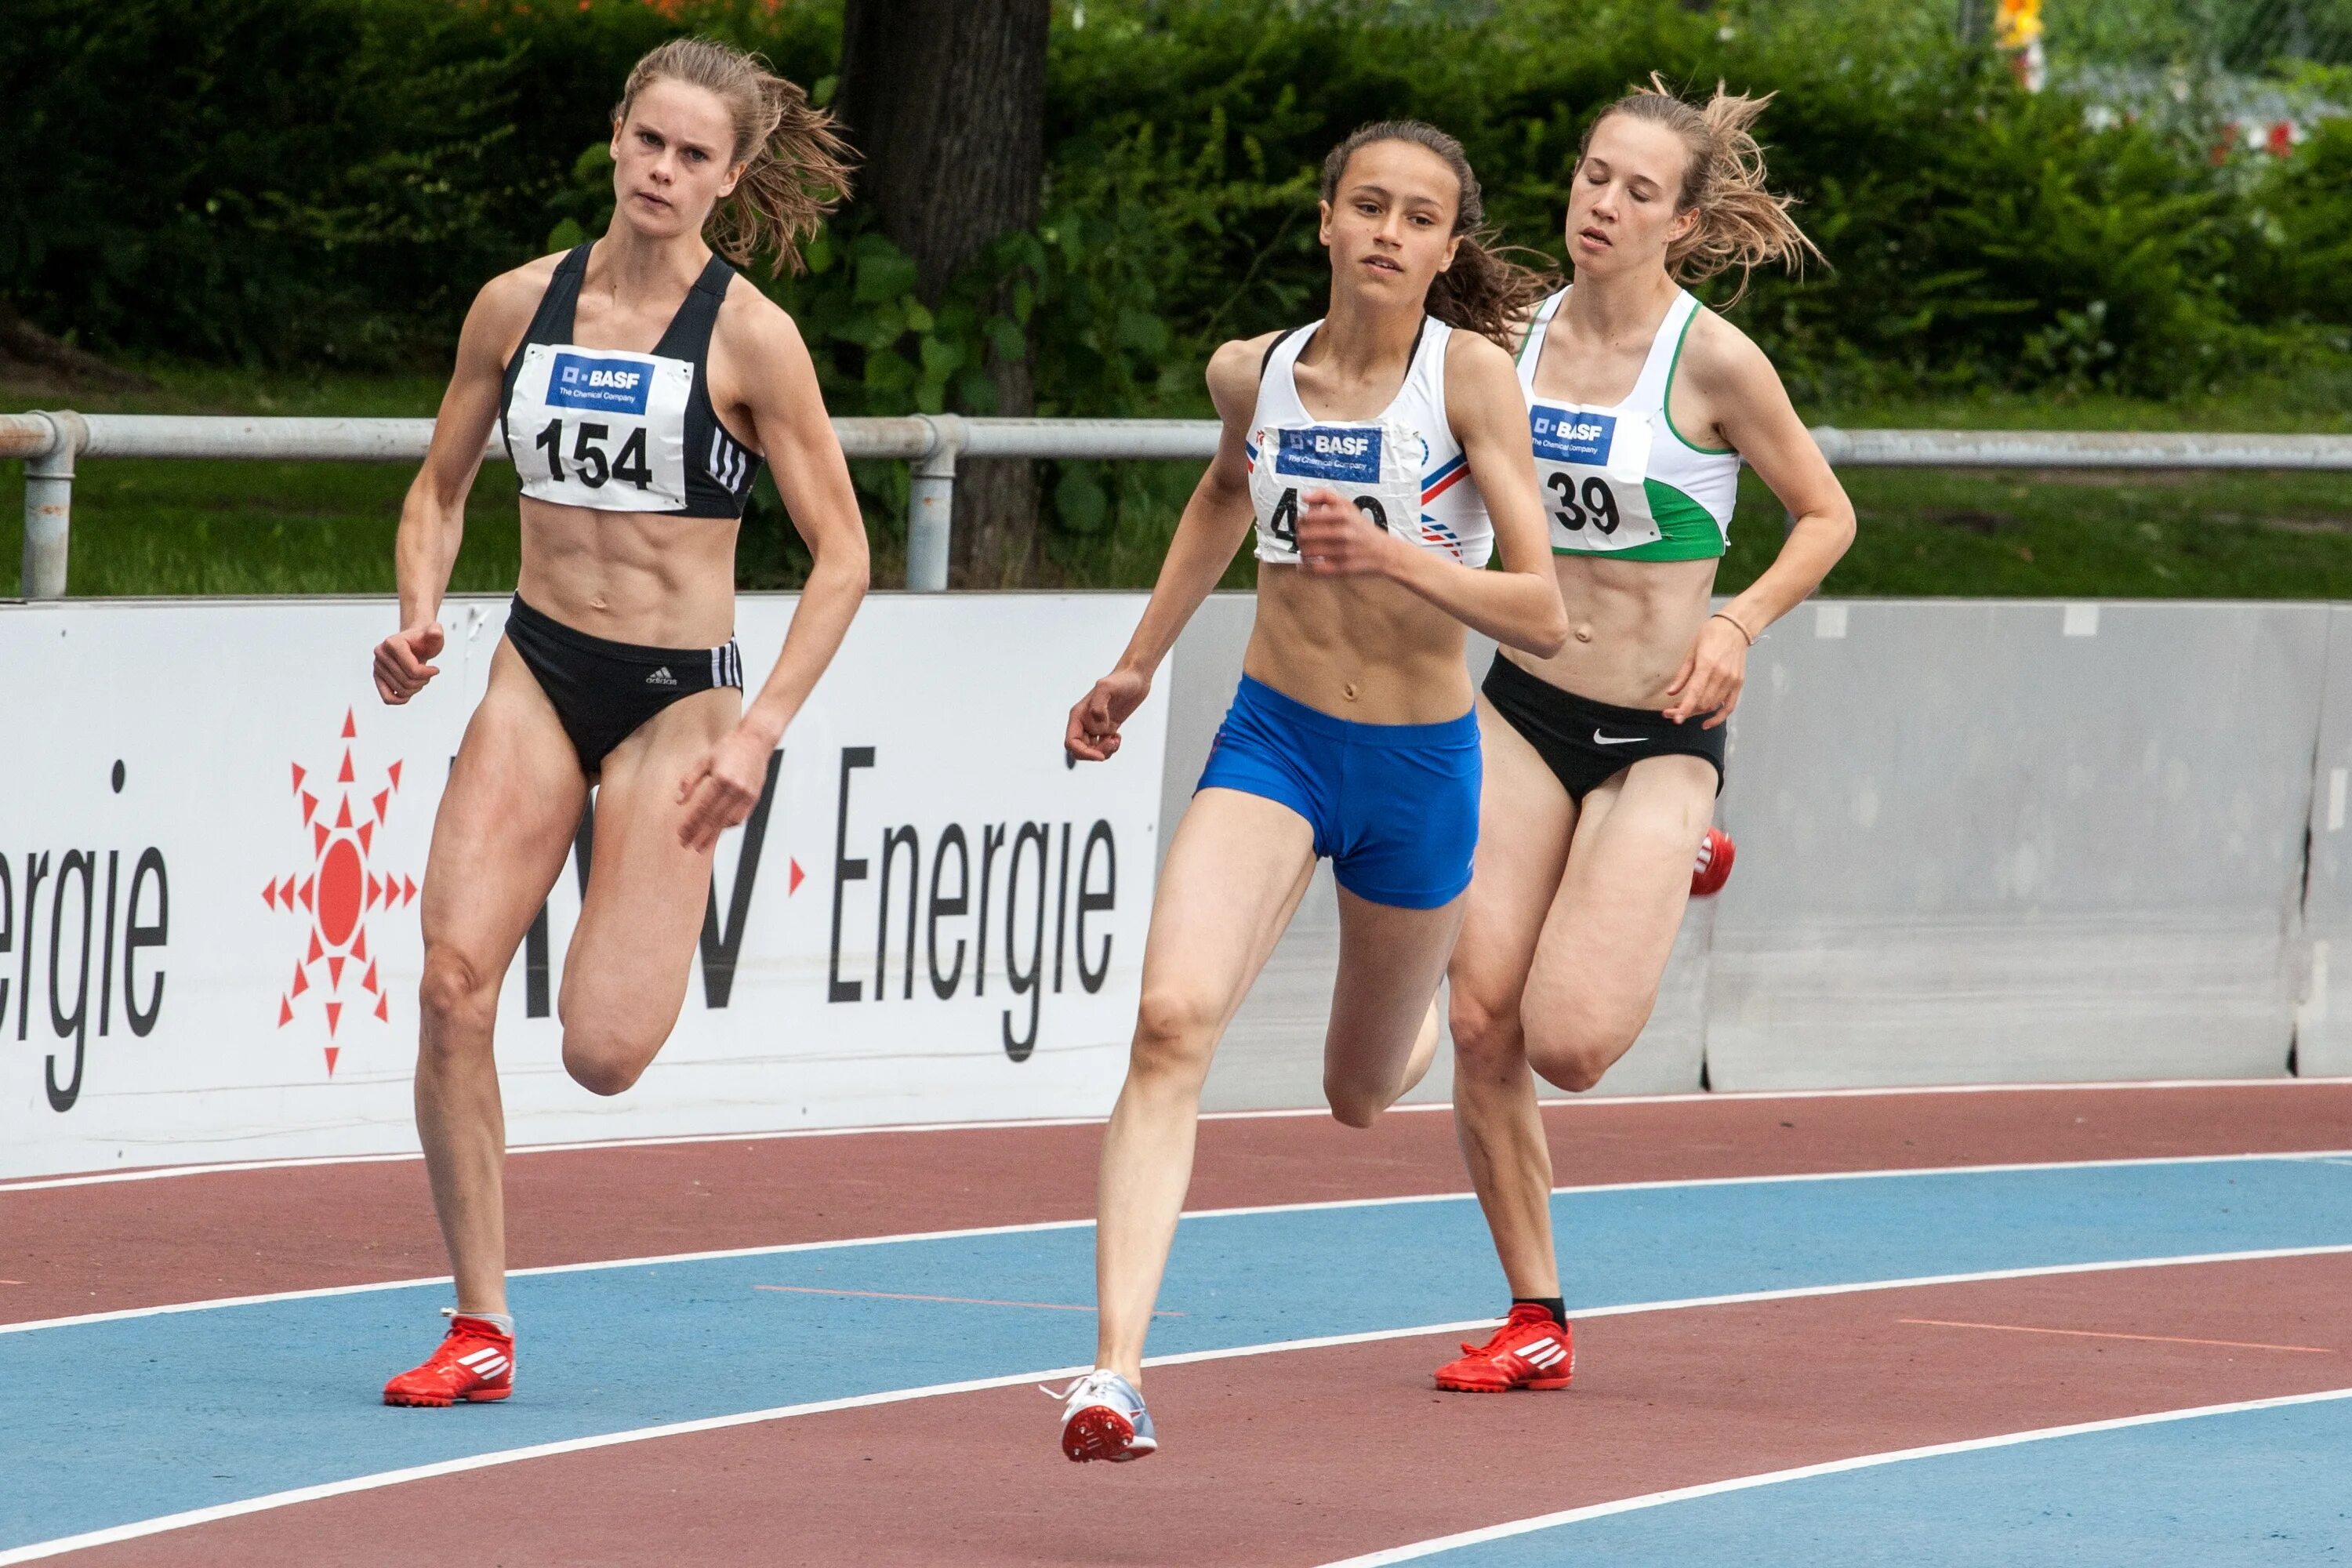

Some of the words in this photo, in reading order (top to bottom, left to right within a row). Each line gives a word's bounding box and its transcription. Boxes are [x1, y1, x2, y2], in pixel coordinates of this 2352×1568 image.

[589, 370, 640, 389] BASF
[559, 387, 573, 396] The
[573, 390, 603, 400] Chemical
[604, 391, 636, 404] Company
[1556, 422, 1602, 441] BASF
[536, 418, 652, 490] 154
[1315, 435, 1369, 456] BASF
[1543, 440, 1569, 451] Chemical
[1569, 444, 1598, 455] Company
[1301, 456, 1333, 467] Chemical
[1334, 459, 1367, 470] Company
[1548, 472, 1620, 535] 39
[828, 746, 1117, 1063] Energie
